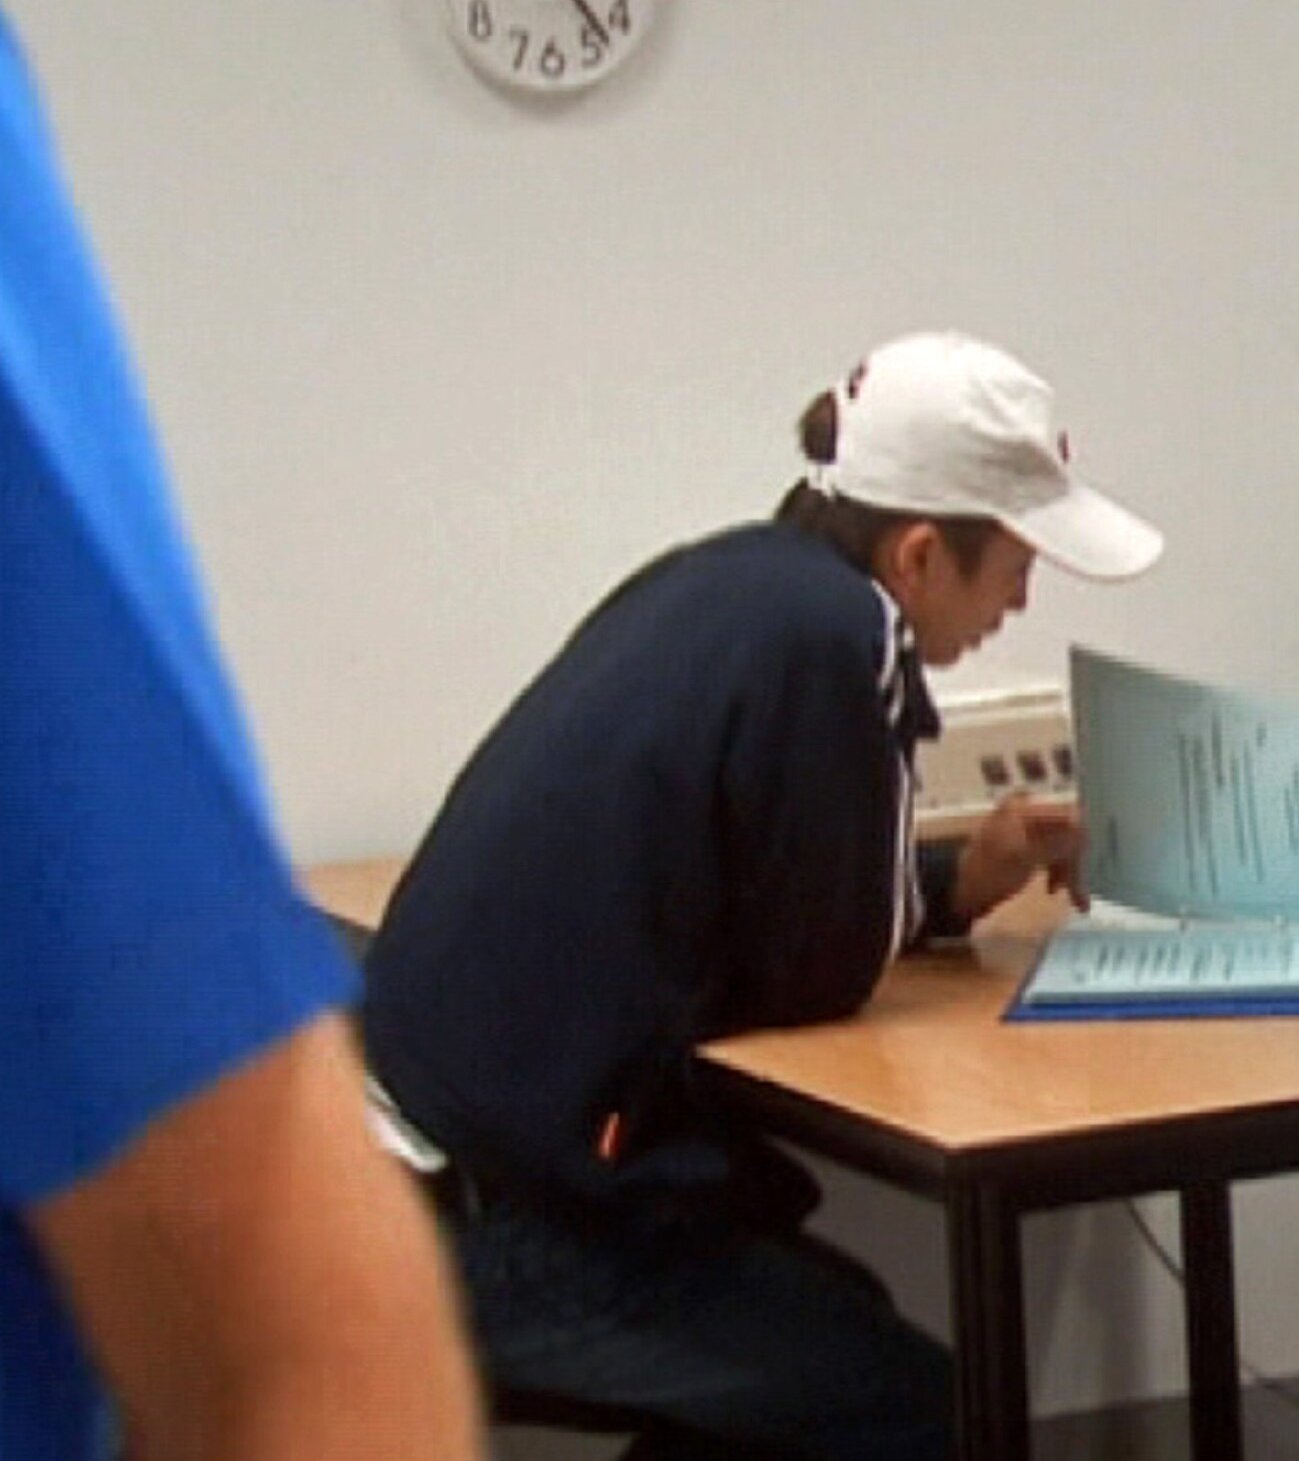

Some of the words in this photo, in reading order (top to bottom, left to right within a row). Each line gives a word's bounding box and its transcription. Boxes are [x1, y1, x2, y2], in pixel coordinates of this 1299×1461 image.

[509, 28, 530, 70] 7
[540, 38, 566, 78] 6
[580, 26, 603, 68] 5
